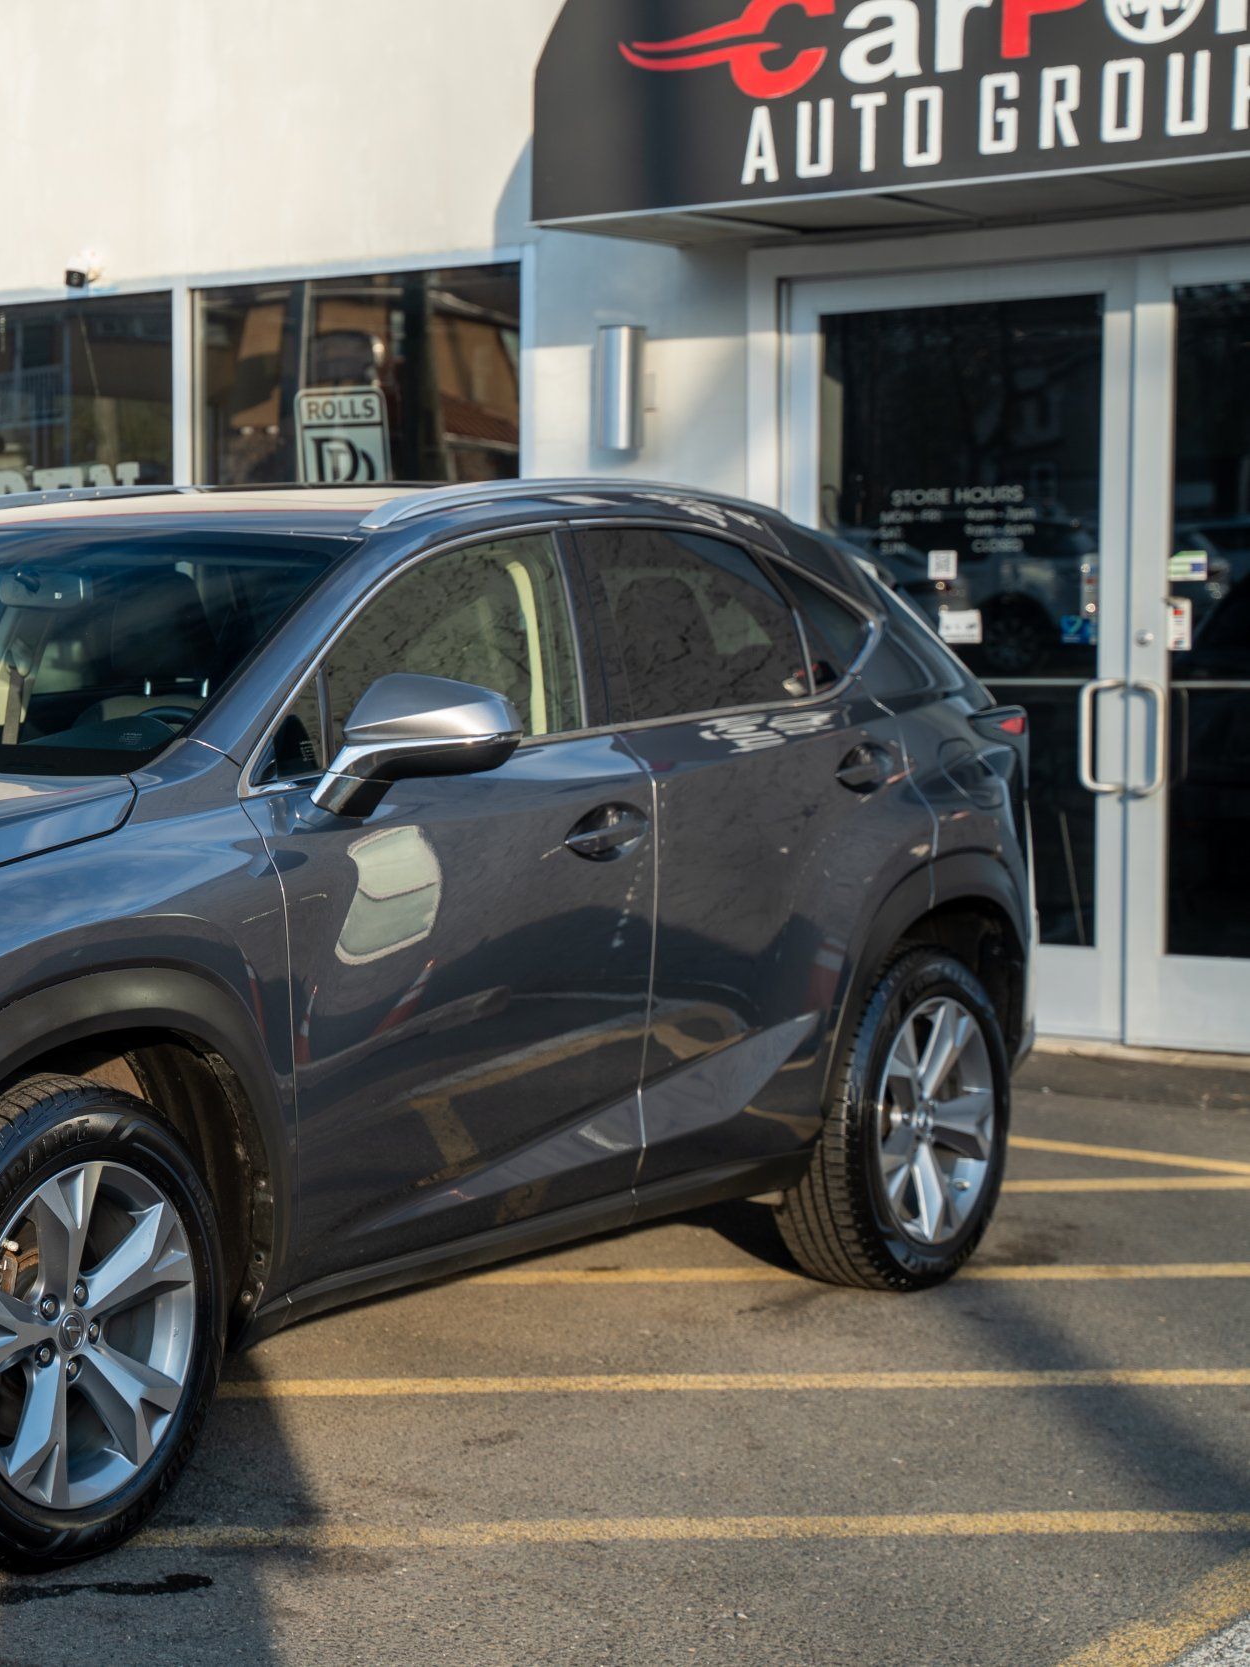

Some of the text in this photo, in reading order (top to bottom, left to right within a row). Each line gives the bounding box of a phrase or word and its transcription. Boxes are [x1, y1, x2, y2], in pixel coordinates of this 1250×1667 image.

[741, 86, 943, 185] AUTO
[306, 398, 375, 420] ROLLS
[891, 485, 1024, 506] STORE HOURS
